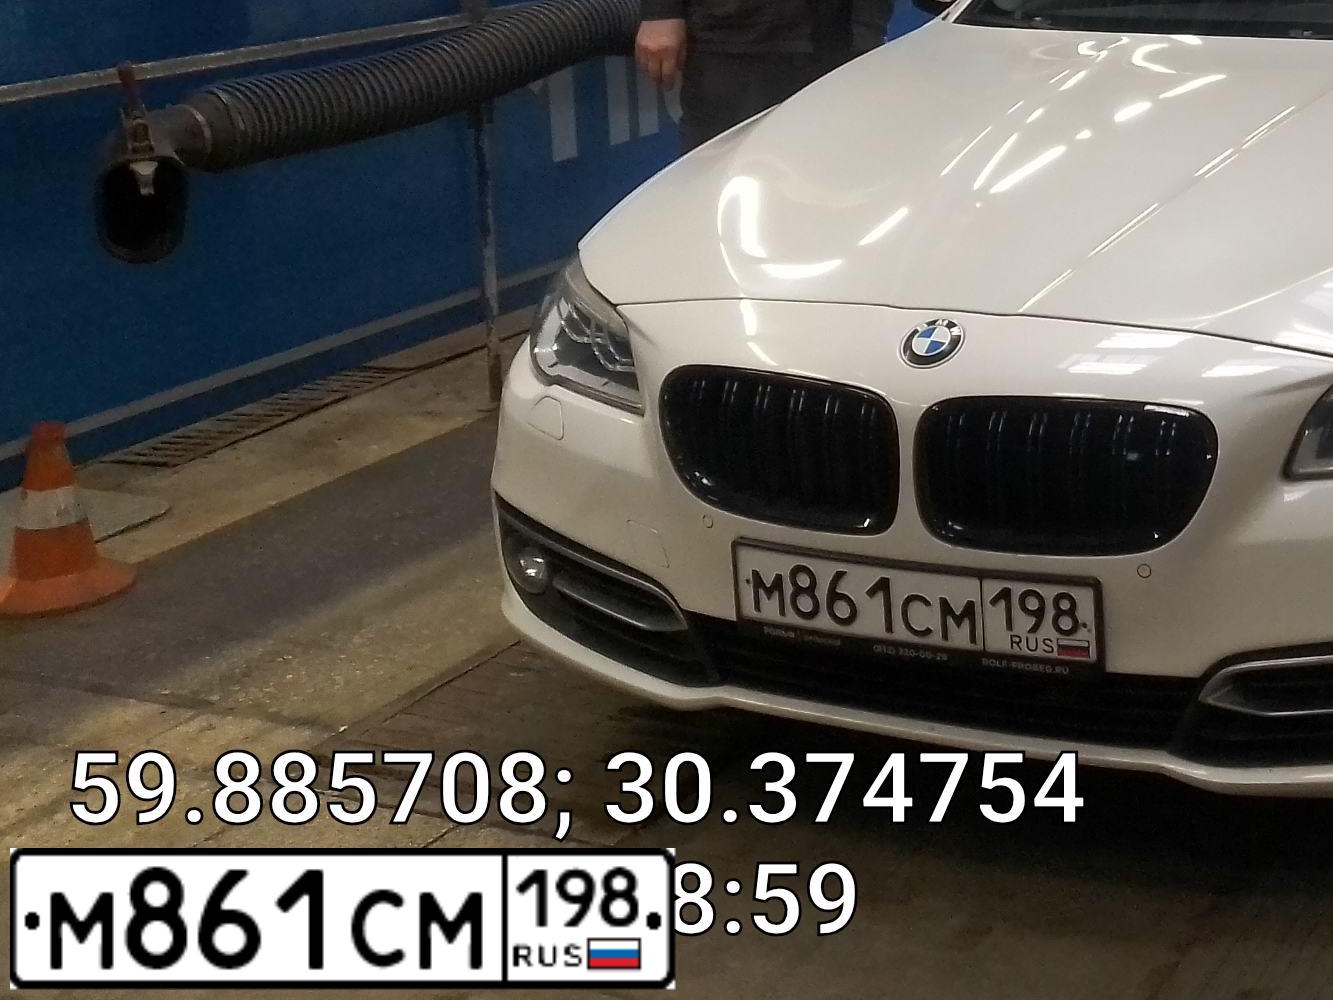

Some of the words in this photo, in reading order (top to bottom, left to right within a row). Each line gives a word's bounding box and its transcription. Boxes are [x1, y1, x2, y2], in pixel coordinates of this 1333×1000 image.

[751, 564, 978, 645] М861СМ
[989, 586, 1080, 636] 198
[1010, 634, 1055, 654] RUS
